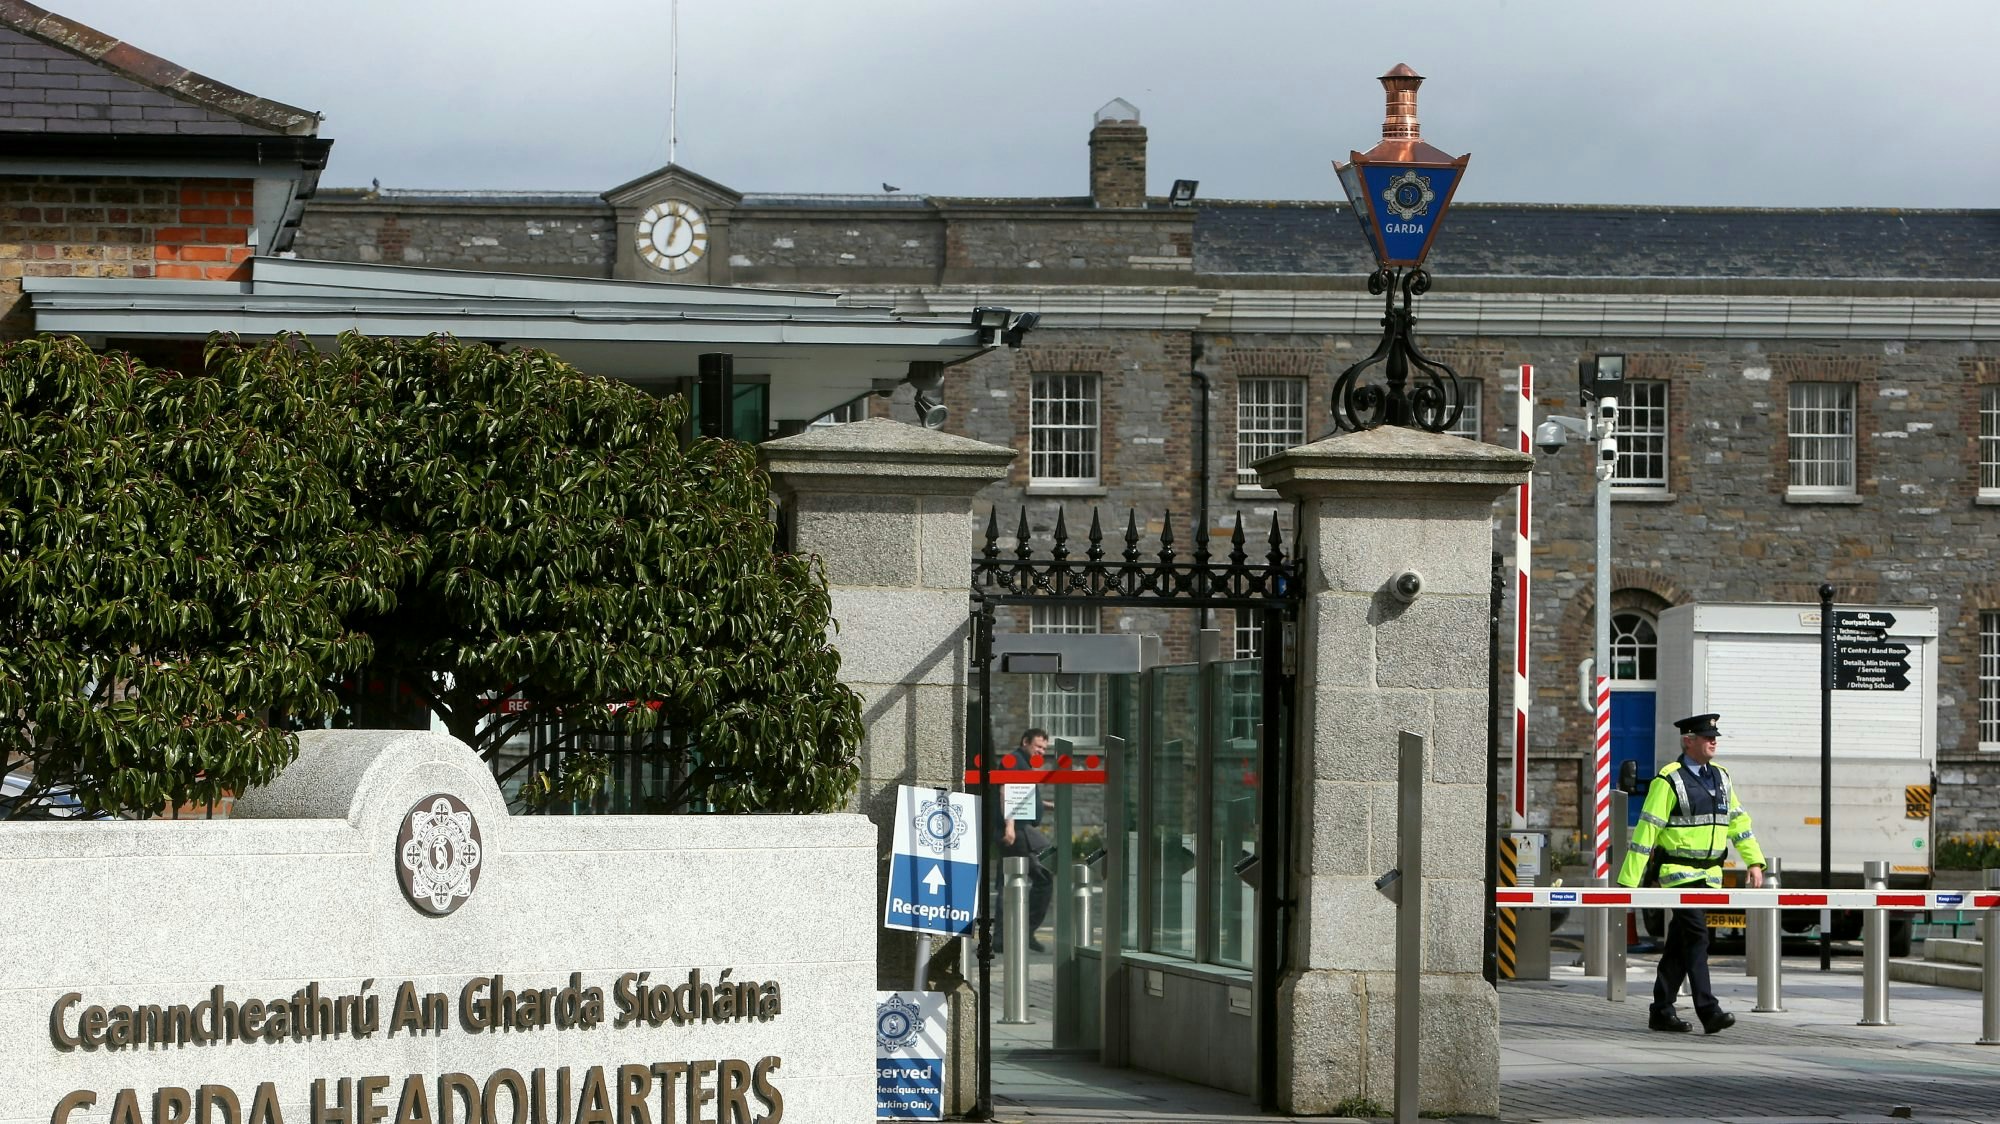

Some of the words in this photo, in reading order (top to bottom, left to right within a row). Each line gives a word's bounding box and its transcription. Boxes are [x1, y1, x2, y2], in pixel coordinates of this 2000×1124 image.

[1385, 223, 1424, 234] GARDA
[1857, 612, 1870, 620] GHQ
[1841, 619, 1867, 627] Courtyard
[1836, 634, 1857, 642] Building
[1856, 675, 1886, 683] Transport
[892, 898, 970, 922] Reception
[388, 980, 449, 1037] An
[459, 972, 605, 1035] Gharda
[613, 968, 783, 1029] Síochána
[876, 1065, 932, 1080] served
[311, 1055, 784, 1124] HEADQUARTERS
[877, 1100, 909, 1111] arking
[910, 1100, 933, 1111] Only
